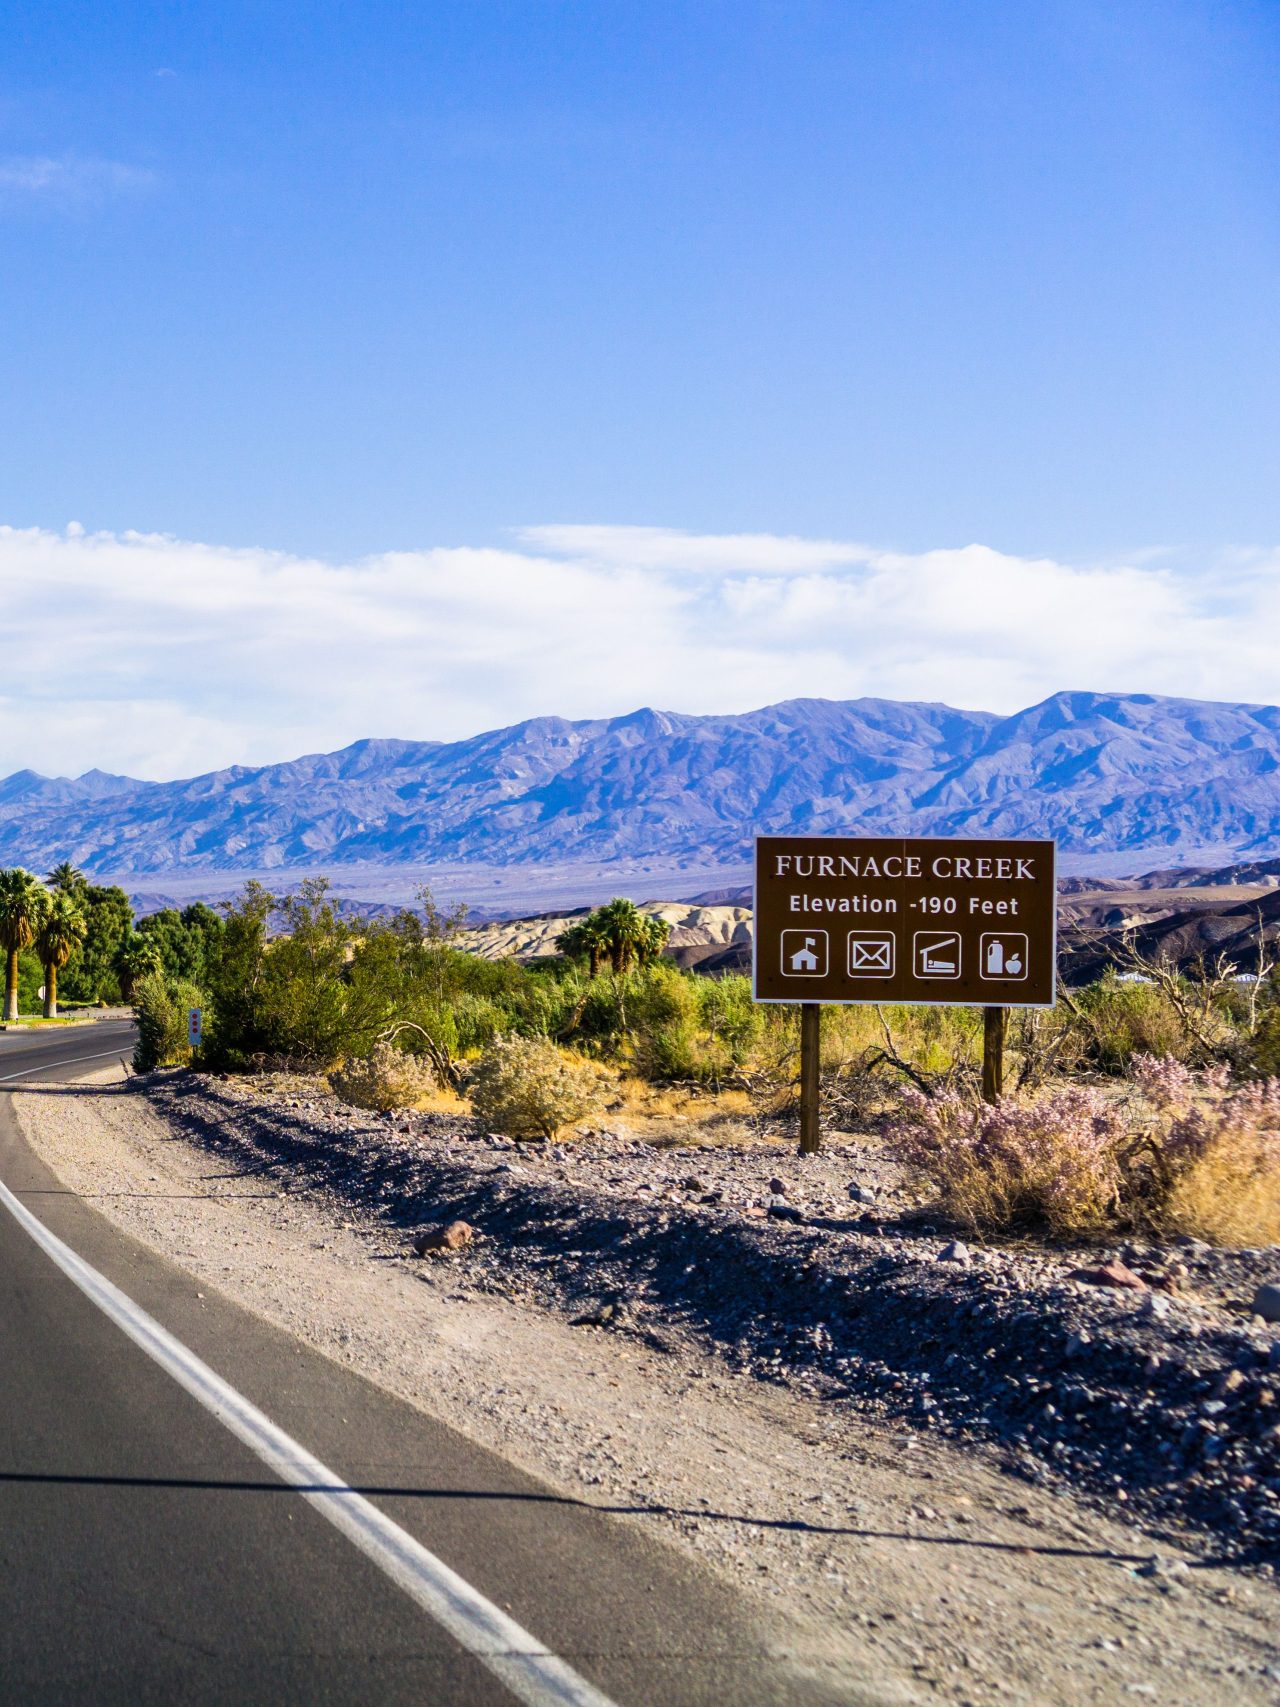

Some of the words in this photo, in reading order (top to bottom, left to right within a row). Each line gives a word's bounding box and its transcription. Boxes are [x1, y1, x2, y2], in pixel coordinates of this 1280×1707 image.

[775, 855, 922, 878] FURNACE
[931, 857, 1036, 880] CREEK
[789, 894, 897, 913] Elevation
[909, 896, 957, 914] -190
[969, 897, 1019, 915] Feet
